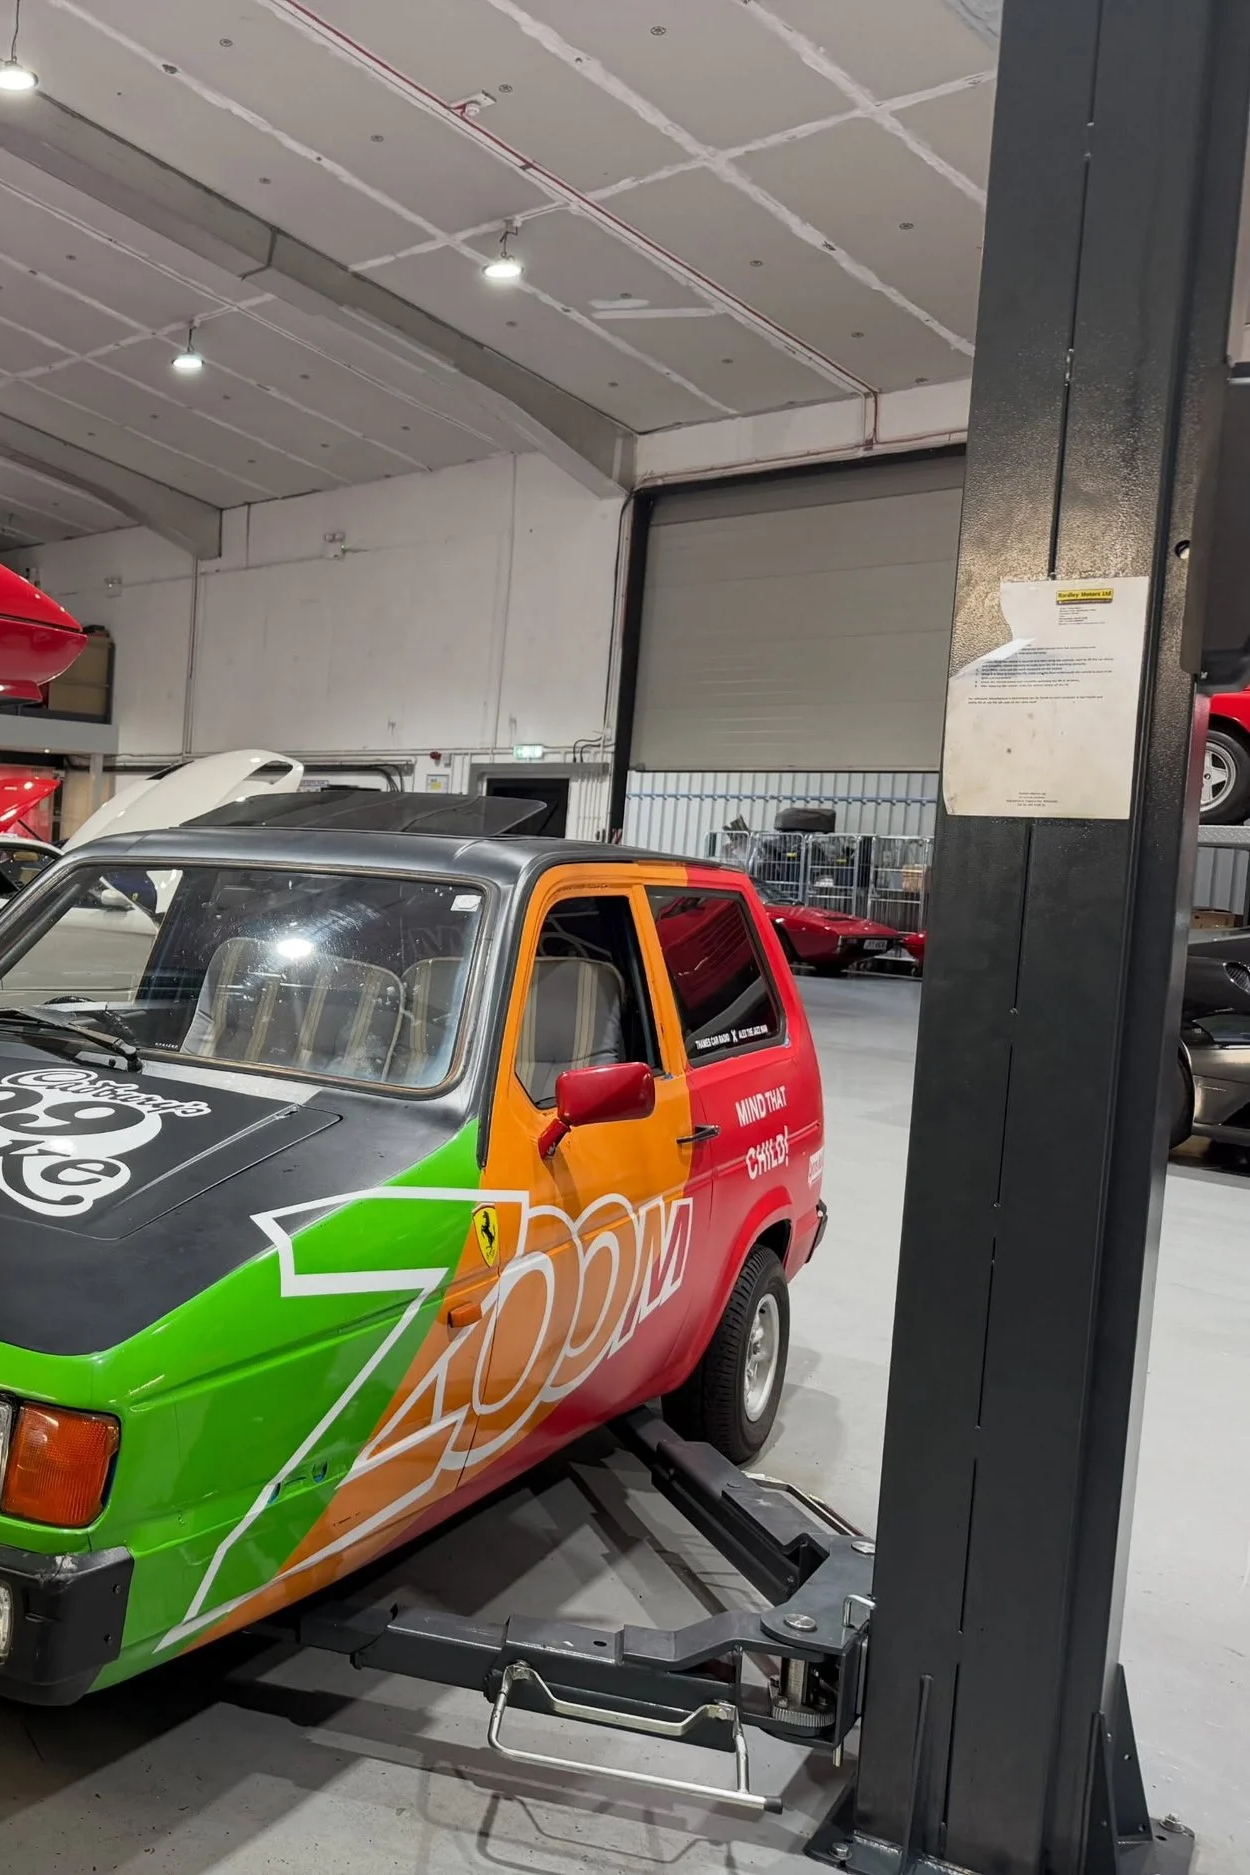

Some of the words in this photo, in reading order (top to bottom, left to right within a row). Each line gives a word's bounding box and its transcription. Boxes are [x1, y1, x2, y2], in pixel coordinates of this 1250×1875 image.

[710, 1036, 720, 1046] CAR
[735, 1093, 767, 1127] MIND
[764, 1085, 787, 1113] THAT
[745, 1125, 789, 1180] CHILD!
[154, 1185, 693, 1654] ZOOM
